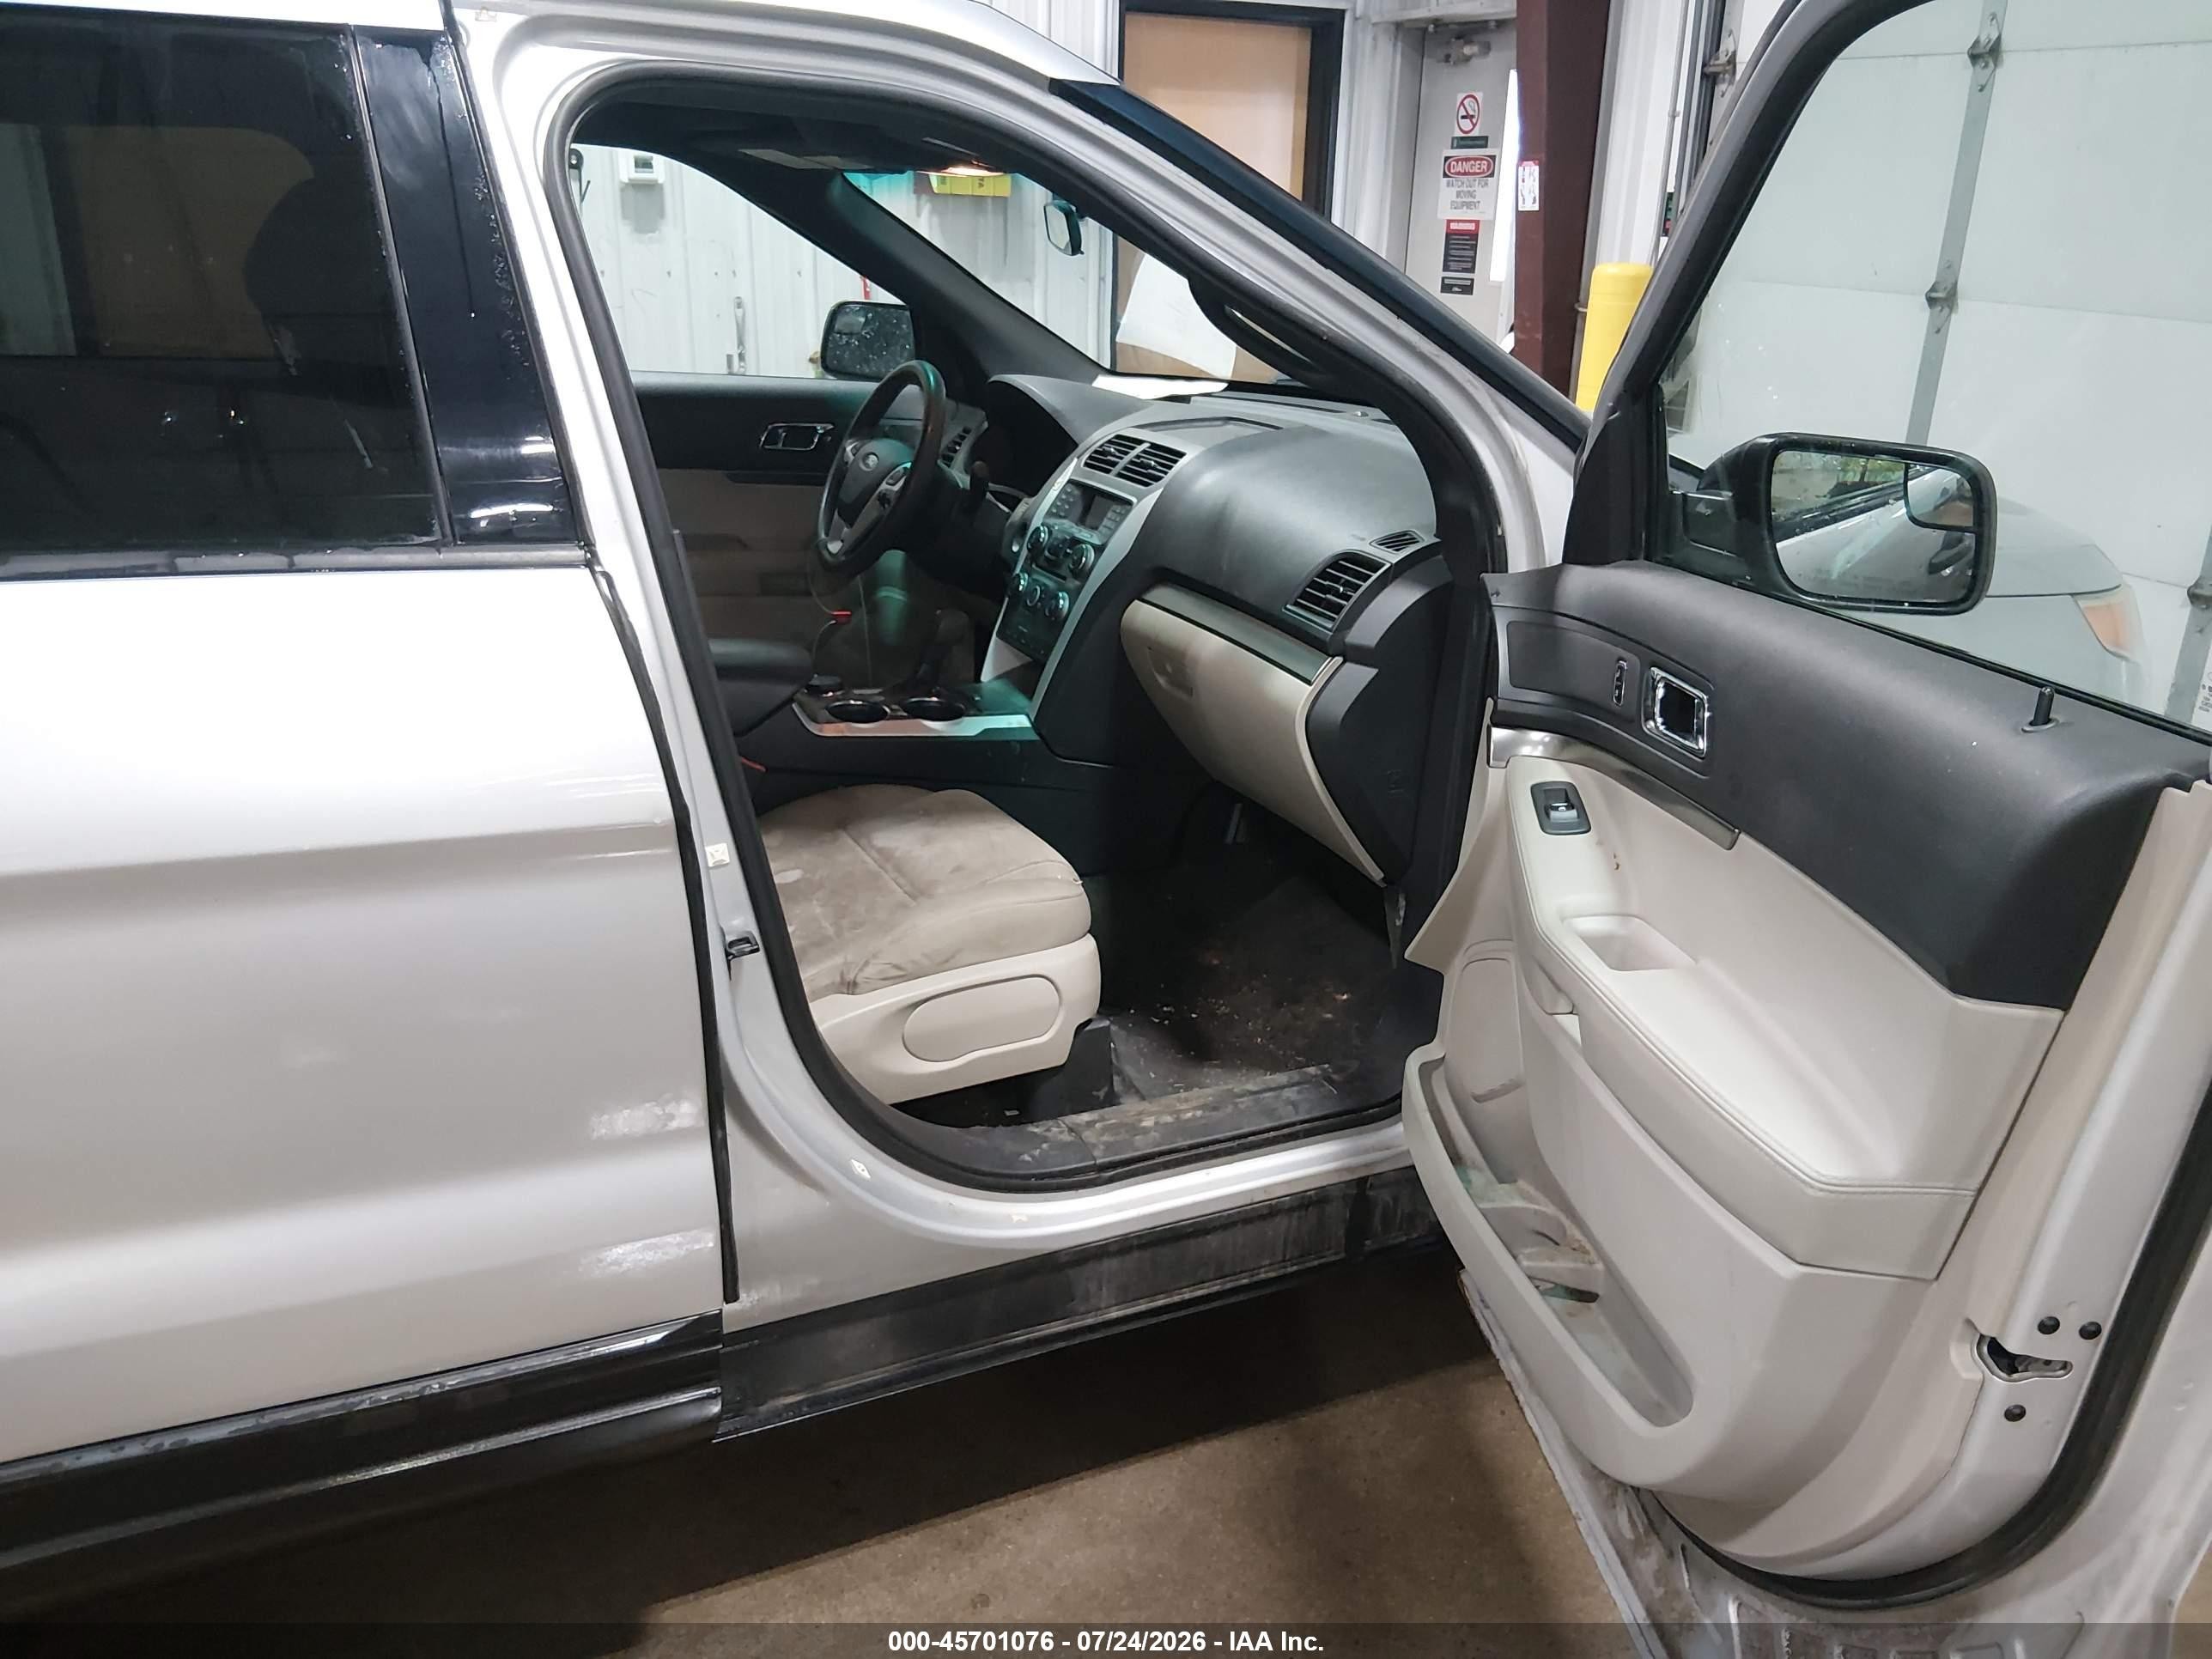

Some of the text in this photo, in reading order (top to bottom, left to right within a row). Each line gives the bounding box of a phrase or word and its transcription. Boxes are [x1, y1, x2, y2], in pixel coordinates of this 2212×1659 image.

[1449, 161, 1488, 173] DANGER
[1446, 179, 1489, 188] WATCH OUT FOR
[1455, 190, 1477, 199] MOVING
[1450, 200, 1480, 210] EQUIPMENT
